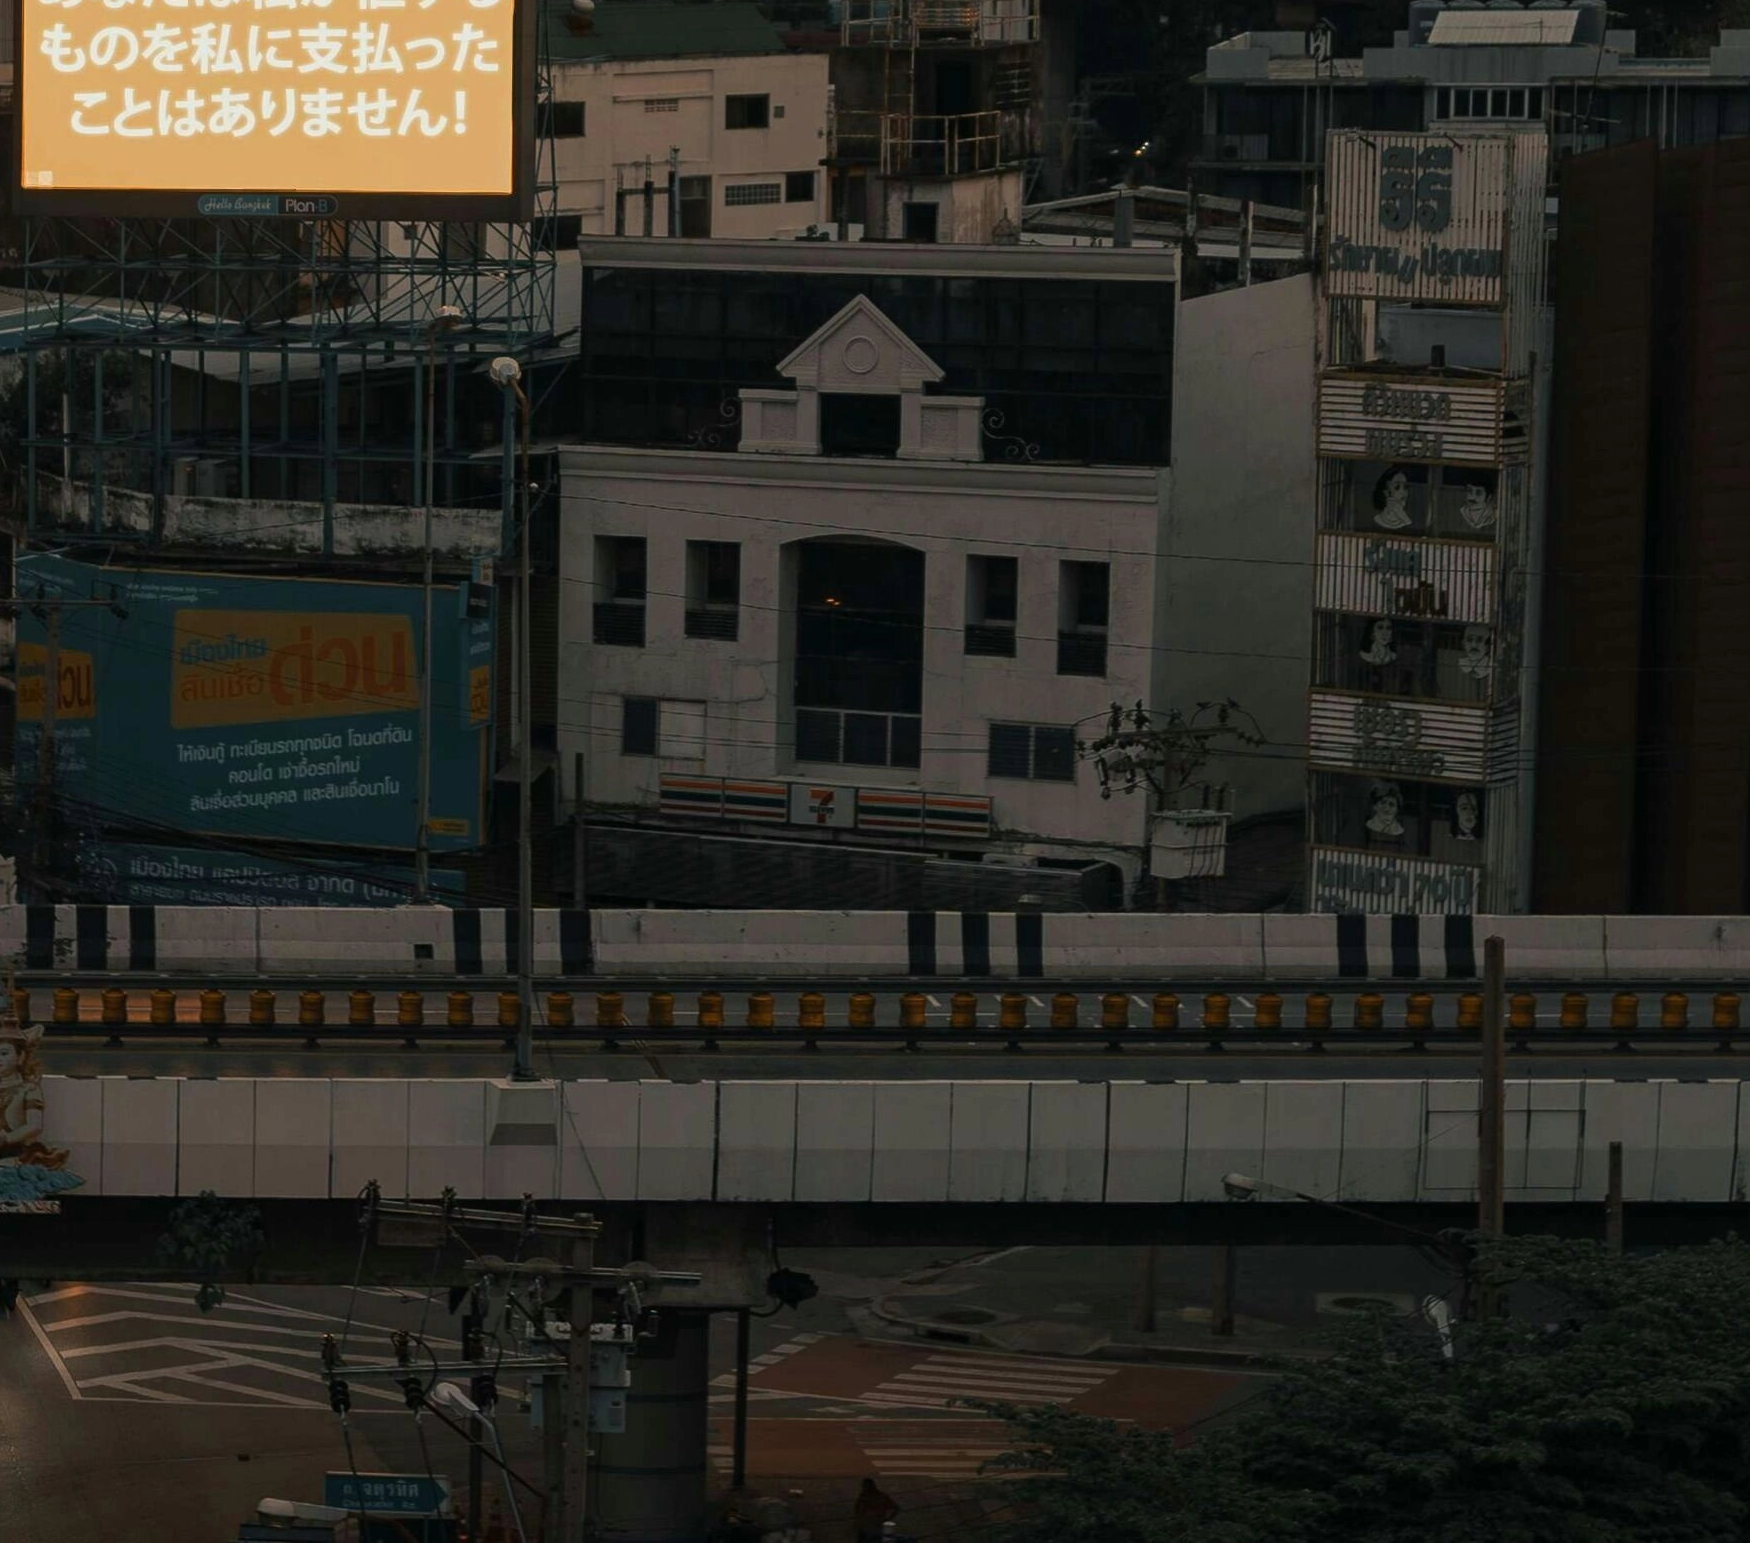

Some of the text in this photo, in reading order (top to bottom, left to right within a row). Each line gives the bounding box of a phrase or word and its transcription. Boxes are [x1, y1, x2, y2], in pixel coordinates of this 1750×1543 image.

[40, 22, 500, 74] ものを私に支払った
[269, 624, 407, 705] ด่วน
